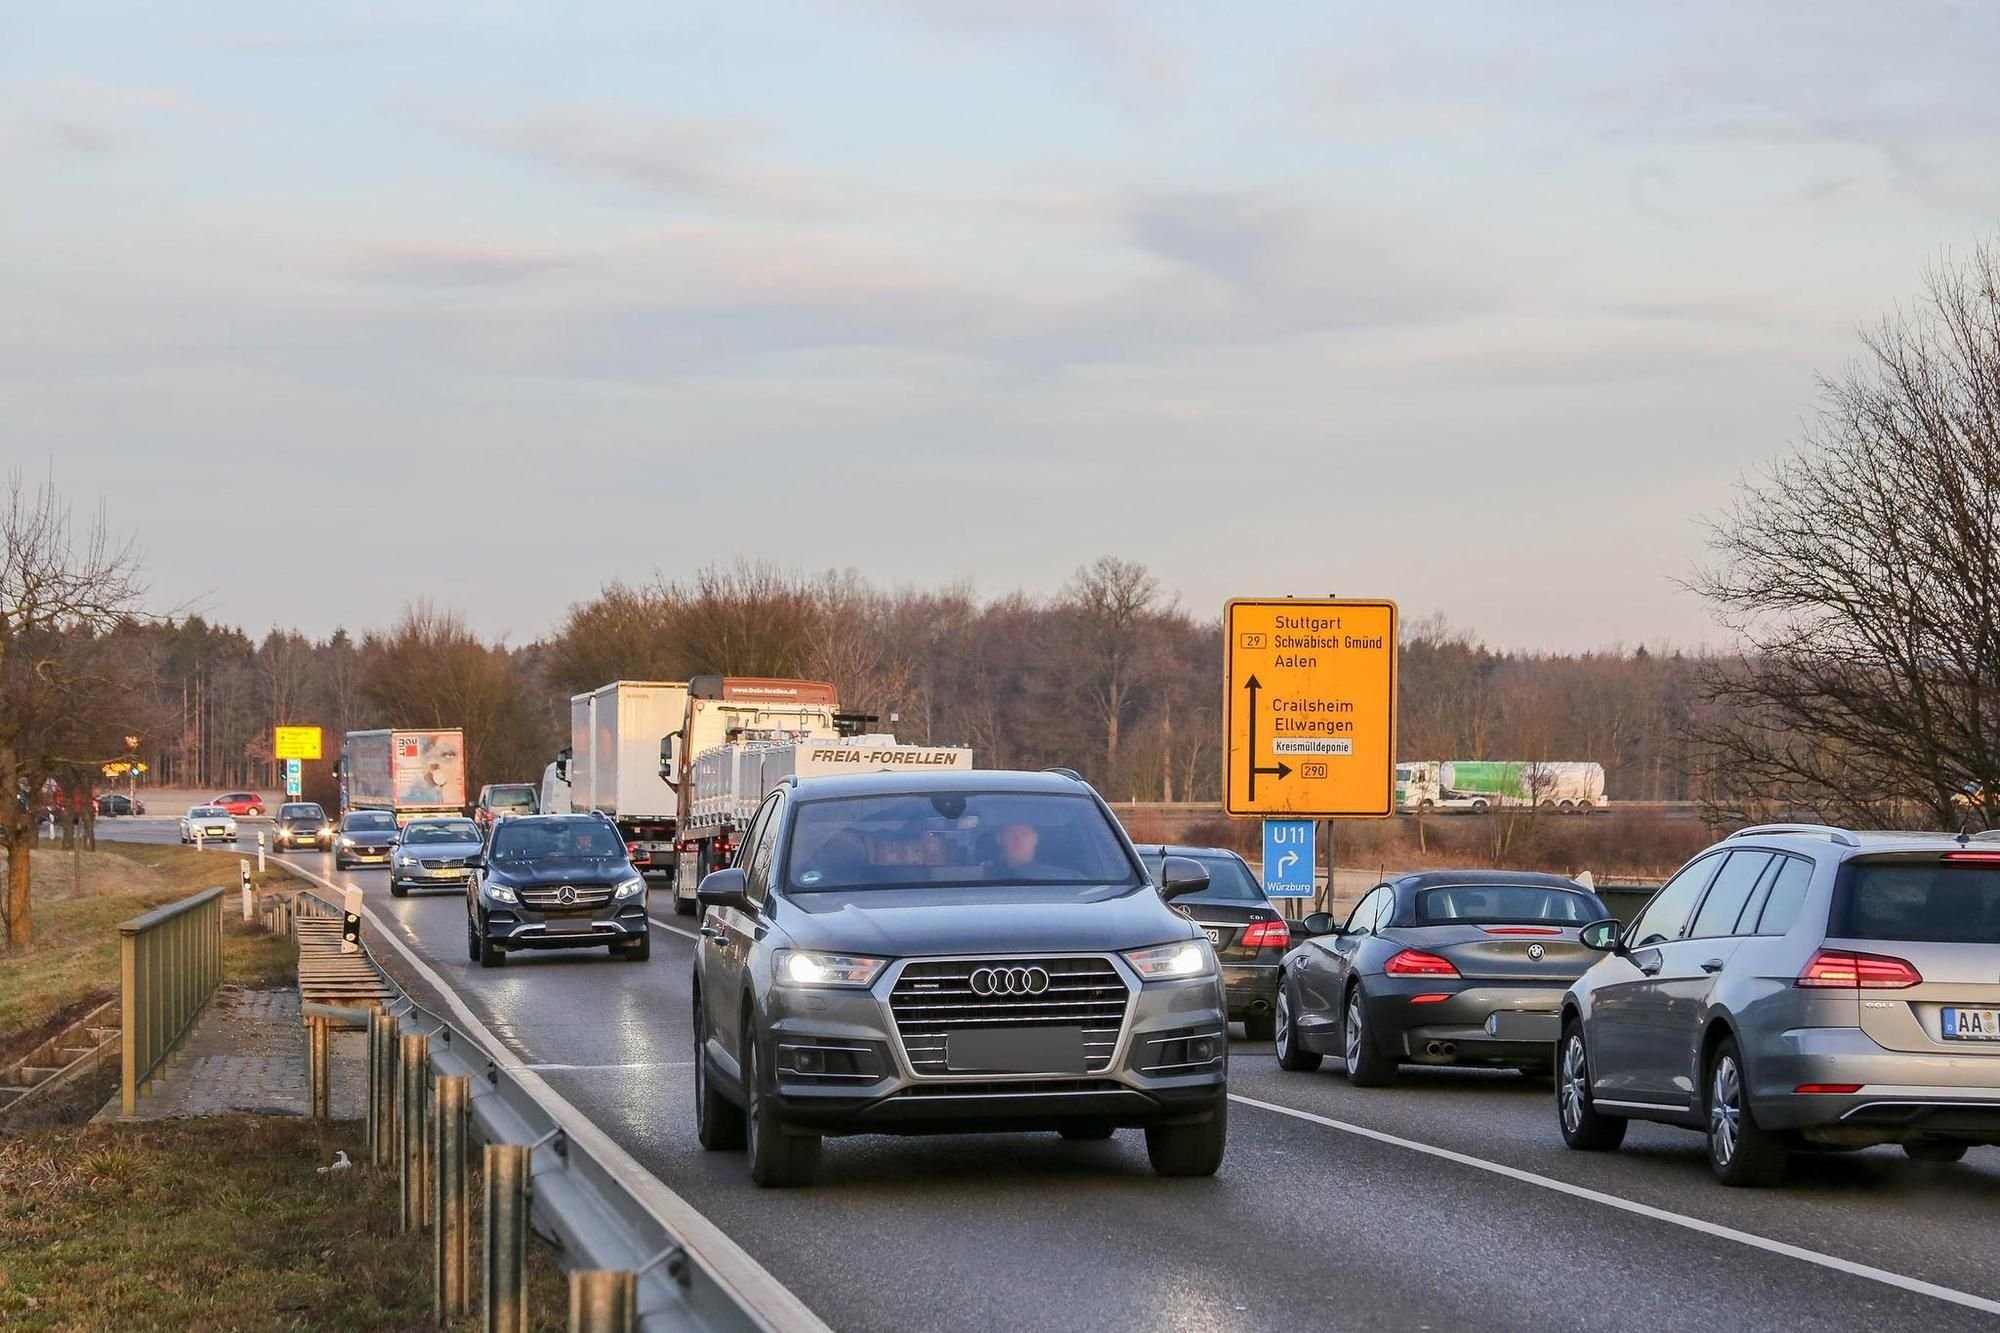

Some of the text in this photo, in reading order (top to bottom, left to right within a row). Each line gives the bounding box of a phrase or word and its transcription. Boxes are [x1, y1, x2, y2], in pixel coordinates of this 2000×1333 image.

[1275, 615, 1341, 631] Stuttgart
[1247, 636, 1260, 646] 29
[1274, 635, 1382, 649] Schwäbisch Gmünd
[1274, 655, 1317, 668] Aalen
[1272, 698, 1353, 712] Crailsheim
[1275, 717, 1353, 735] Ellwangen
[1276, 740, 1349, 754] Kreismülldeponie
[1304, 765, 1324, 777] 290
[1267, 881, 1311, 893] Würzburg
[1959, 1012, 1982, 1033] AA
